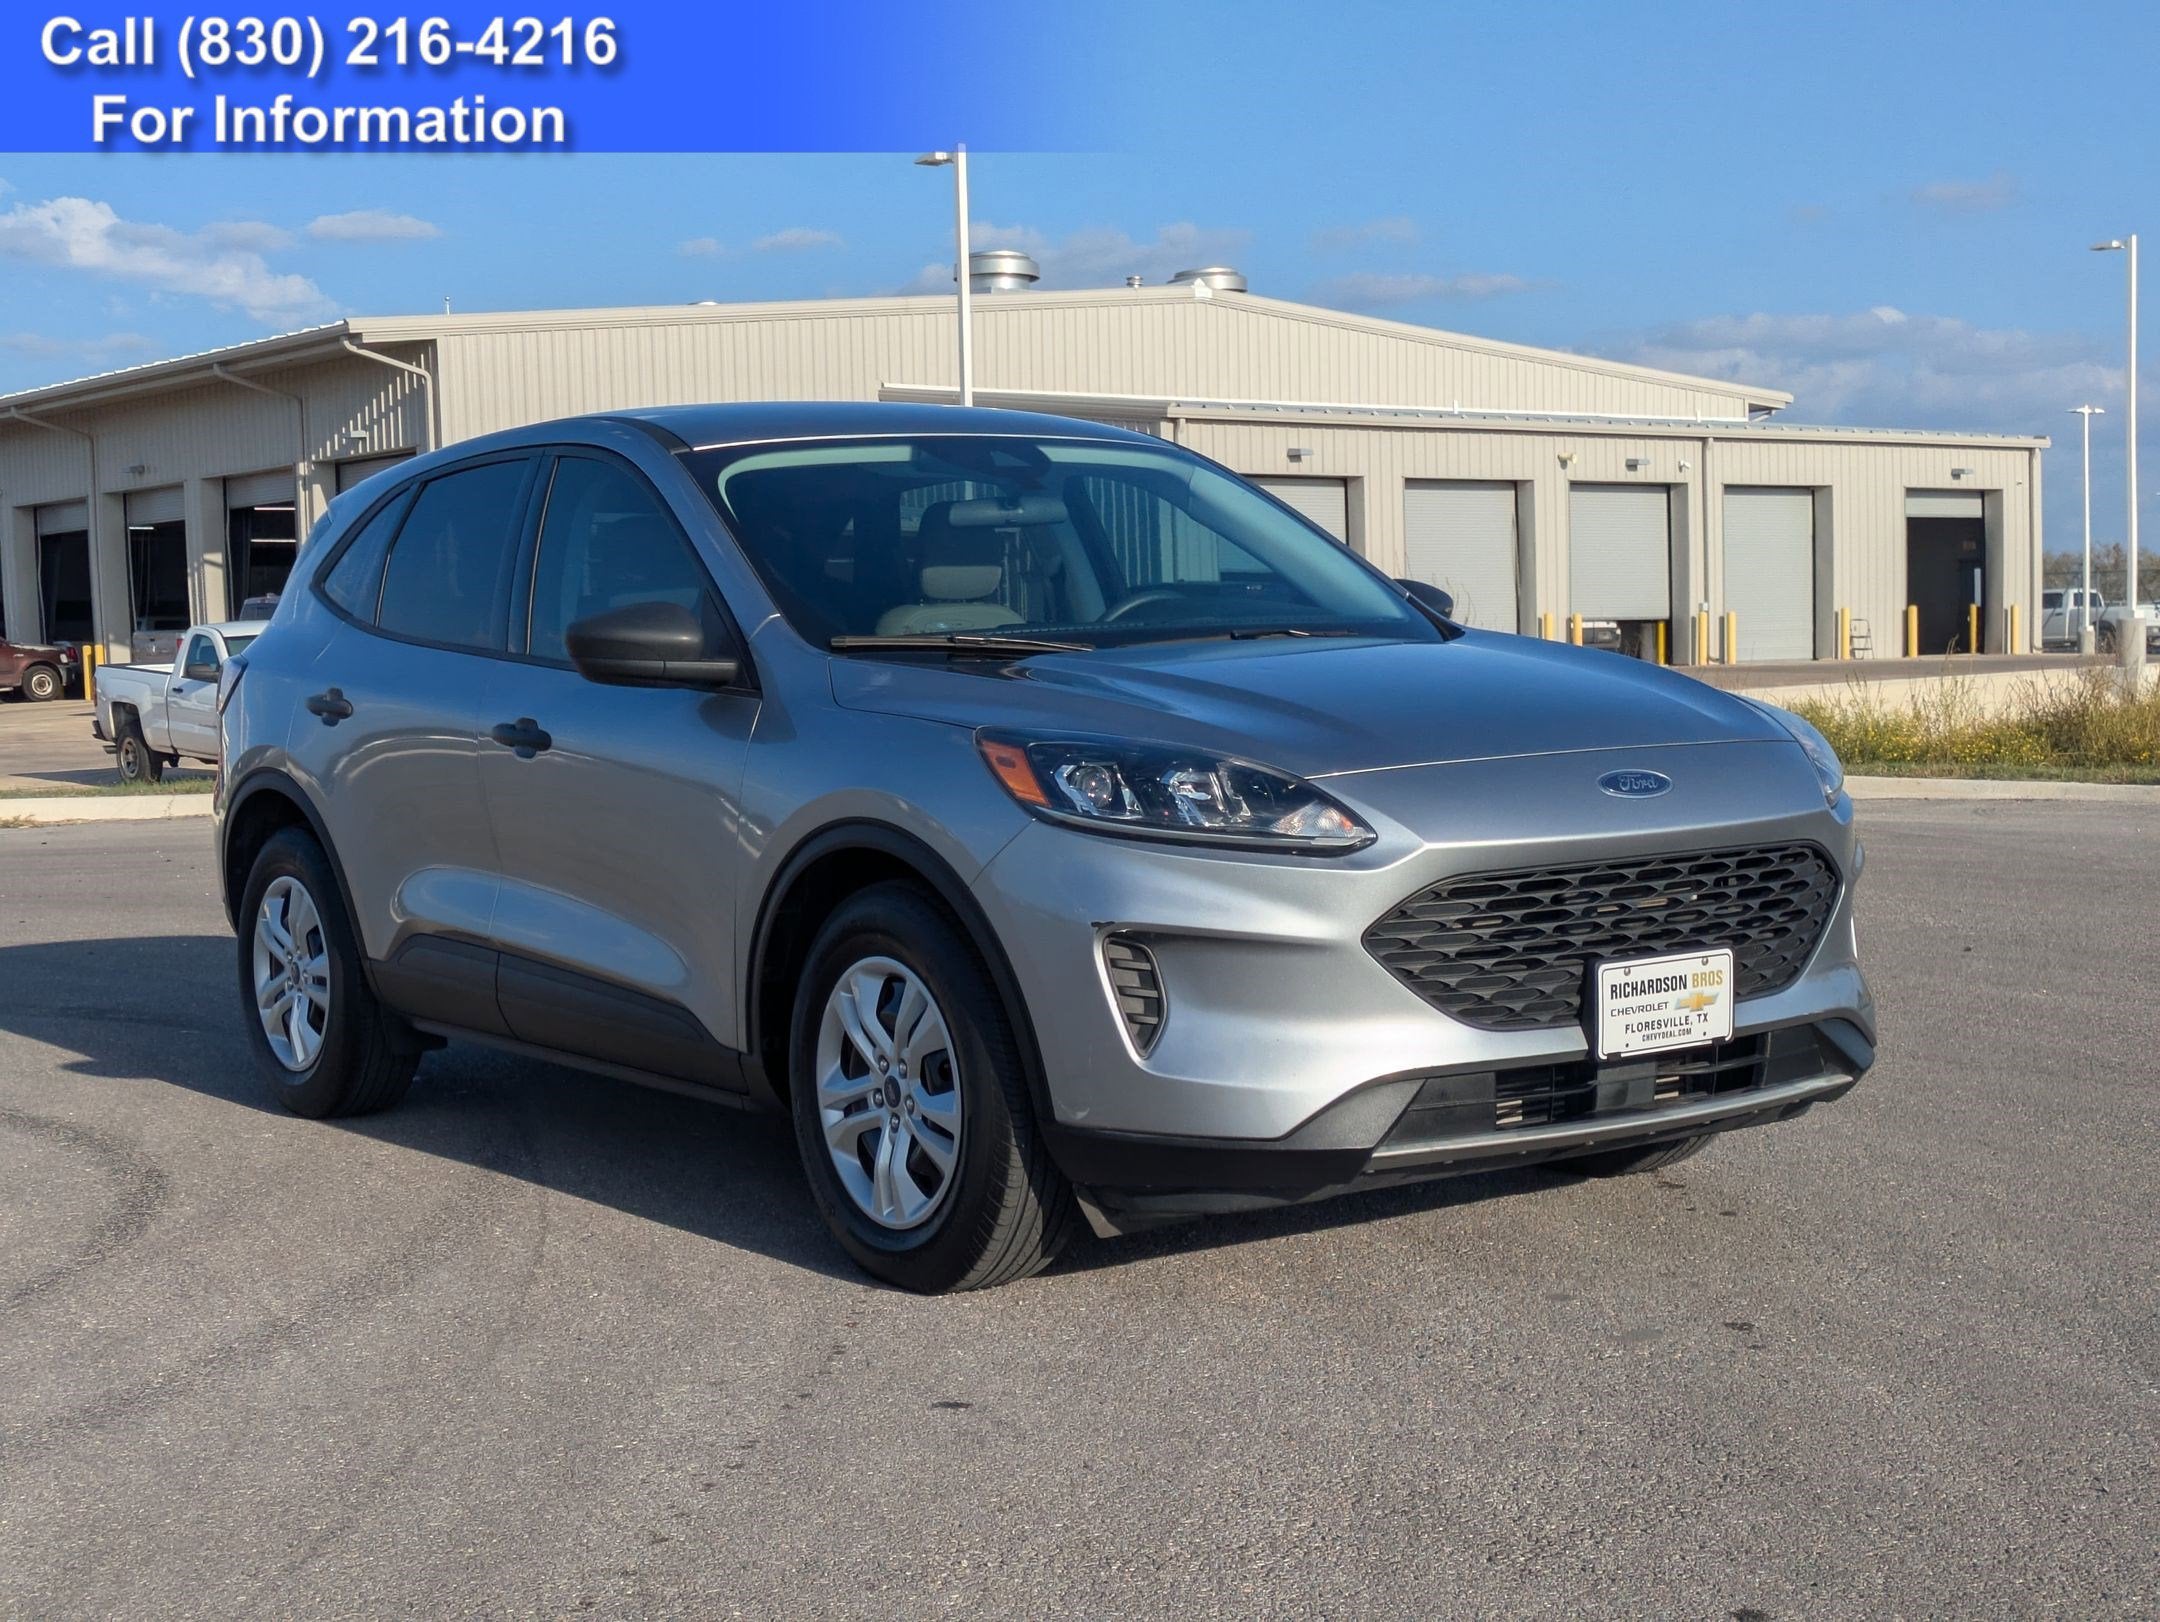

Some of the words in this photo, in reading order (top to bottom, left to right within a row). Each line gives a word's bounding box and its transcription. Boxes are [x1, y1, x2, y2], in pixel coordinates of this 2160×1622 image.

[1619, 774, 1658, 791] Ford
[1610, 974, 1687, 1000] RICHARDSON
[1692, 970, 1723, 988] BROS
[1610, 1001, 1669, 1017] CHEVROLET
[1625, 1015, 1693, 1034] FLORESVILLE,
[1697, 1013, 1708, 1023] TX
[1642, 1027, 1692, 1042] CHEVYDEAL.COM
